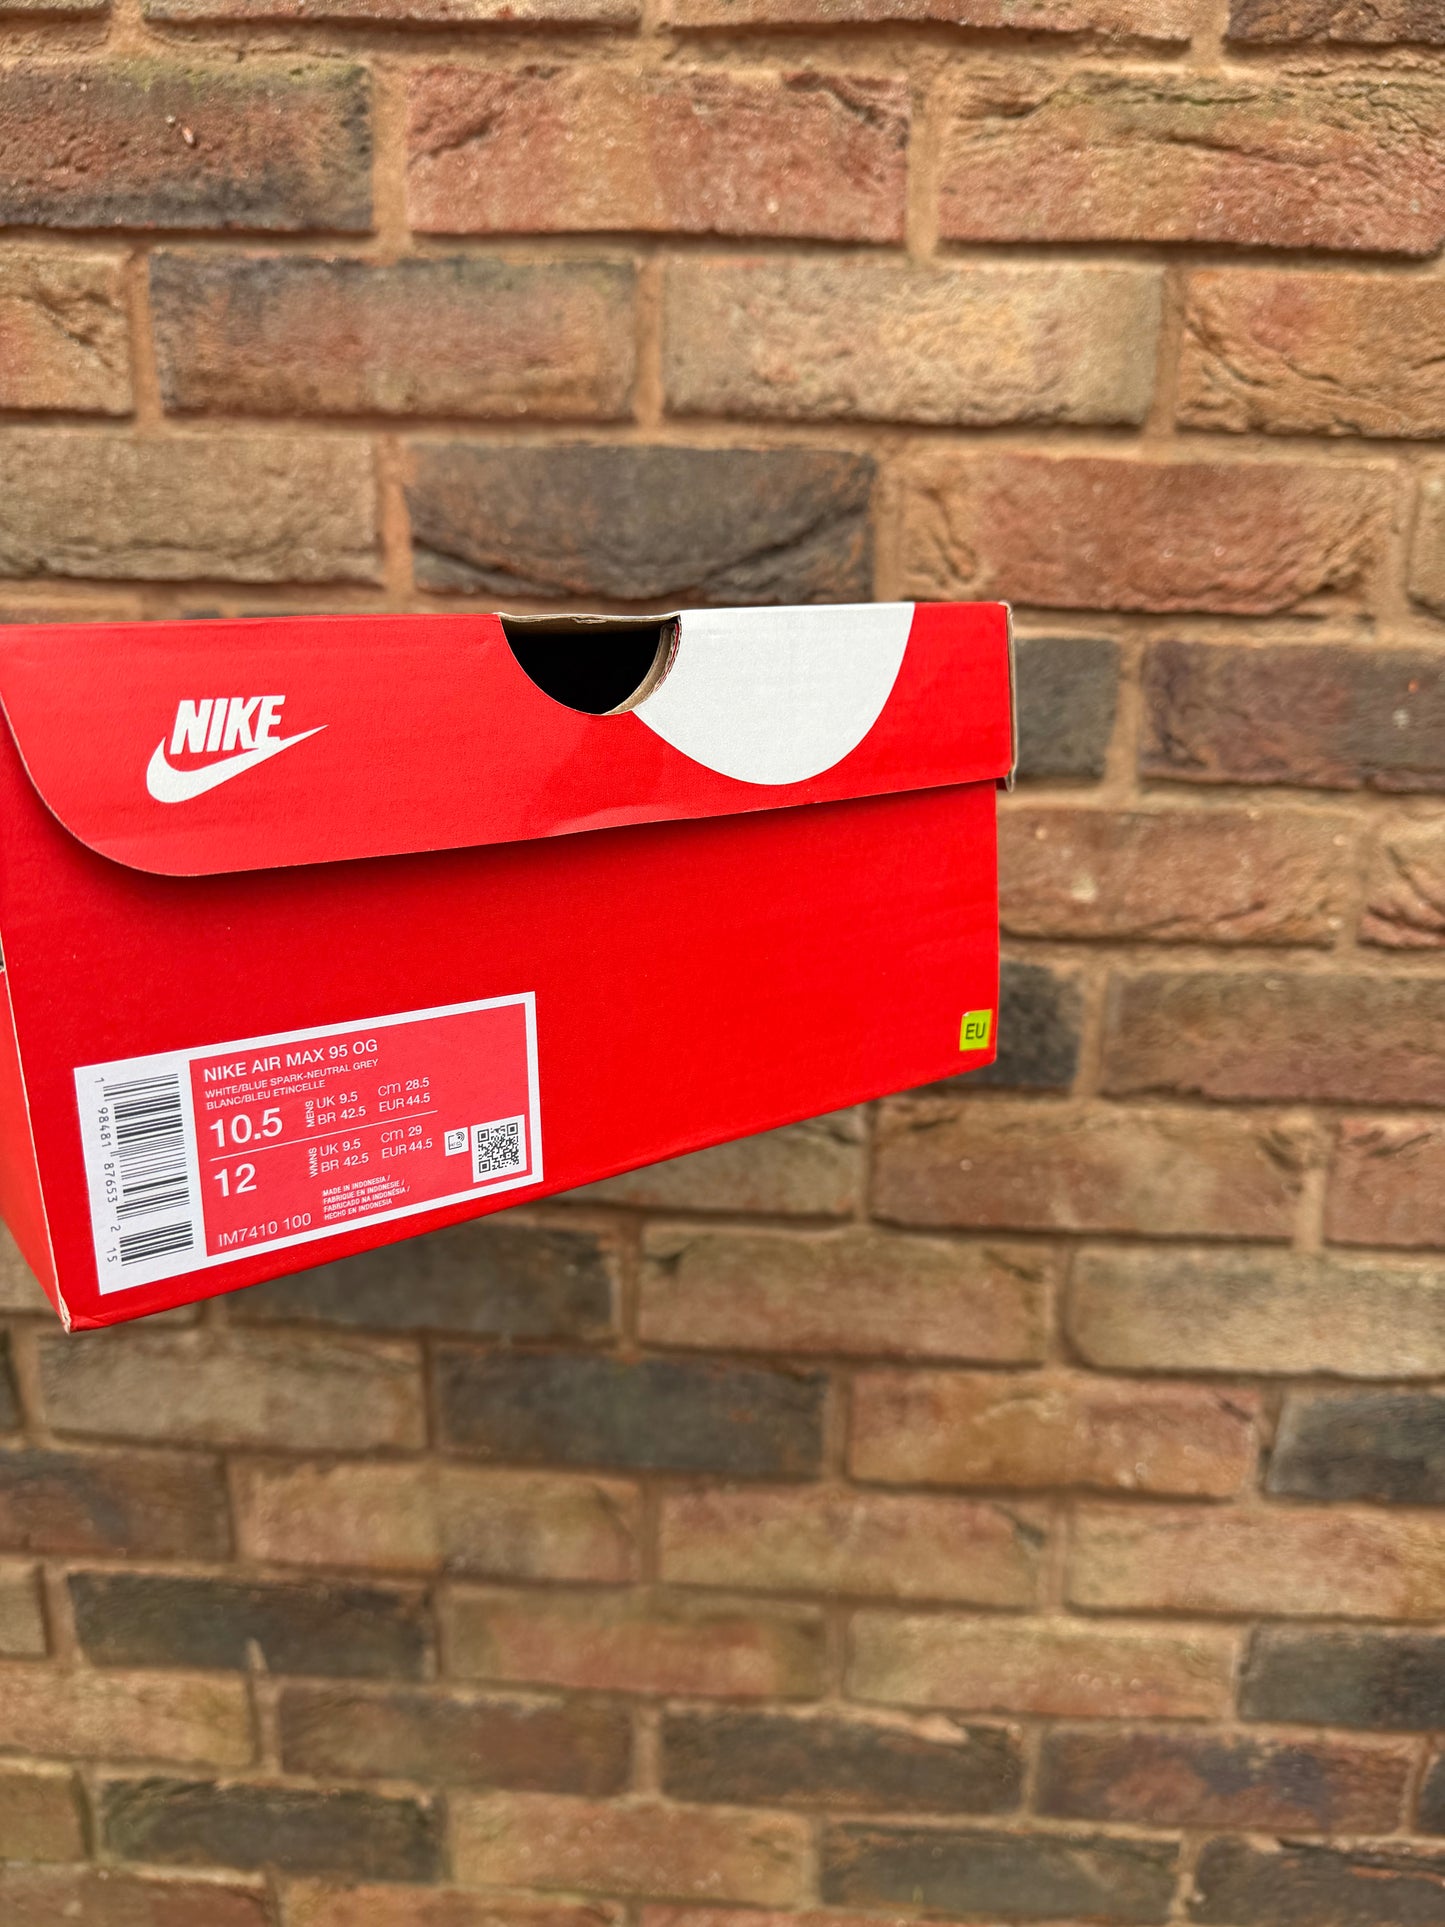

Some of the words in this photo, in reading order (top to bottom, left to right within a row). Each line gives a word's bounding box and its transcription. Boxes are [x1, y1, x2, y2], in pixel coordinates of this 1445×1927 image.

[169, 694, 287, 756] NIKE
[965, 1022, 986, 1040] EU
[203, 1062, 247, 1082] NIKE
[251, 1055, 282, 1074] AIR
[286, 1048, 325, 1067] MAX
[329, 1044, 348, 1059] 95
[352, 1039, 378, 1055] OG
[205, 1081, 268, 1099] WHITE/BLUE
[270, 1065, 351, 1087] SPARK-NEUTRAL
[353, 1059, 379, 1071] GREY
[405, 1077, 430, 1091] 28.5
[206, 1090, 271, 1110] BLANC/BLEU
[273, 1080, 326, 1097] ETINCELLE
[316, 1096, 336, 1109] UK
[339, 1091, 358, 1104] 9.5
[379, 1098, 405, 1113] EUR
[406, 1092, 431, 1106] 44.5
[305, 1100, 316, 1128] MENS
[317, 1112, 337, 1125] BR
[340, 1106, 367, 1120] 42.5
[98, 1107, 112, 1148] 98481
[209, 1107, 283, 1148] 10.5
[408, 1125, 422, 1137] 29
[320, 1143, 339, 1157] UK
[342, 1138, 361, 1151] 9.5
[381, 1144, 407, 1159] EUR
[408, 1138, 433, 1152] 44.5
[308, 1147, 318, 1178] WMNS
[321, 1159, 340, 1173] BR
[343, 1152, 369, 1167] 42.5
[103, 1162, 118, 1203] 87653
[213, 1163, 257, 1197] 12
[322, 1187, 341, 1196] MADE
[352, 1175, 386, 1190] INDONESIA
[323, 1191, 355, 1204] FABRIQUE
[356, 1188, 365, 1196] EN
[323, 1199, 360, 1213] FABRICADO
[361, 1195, 371, 1204] NA
[324, 1209, 346, 1220] HECHO
[348, 1206, 357, 1214] EN
[358, 1198, 393, 1212] INDONESIA
[110, 1225, 121, 1233] 2
[218, 1221, 278, 1247] IM7410
[283, 1212, 312, 1230] 100
[106, 1247, 118, 1263] 15
